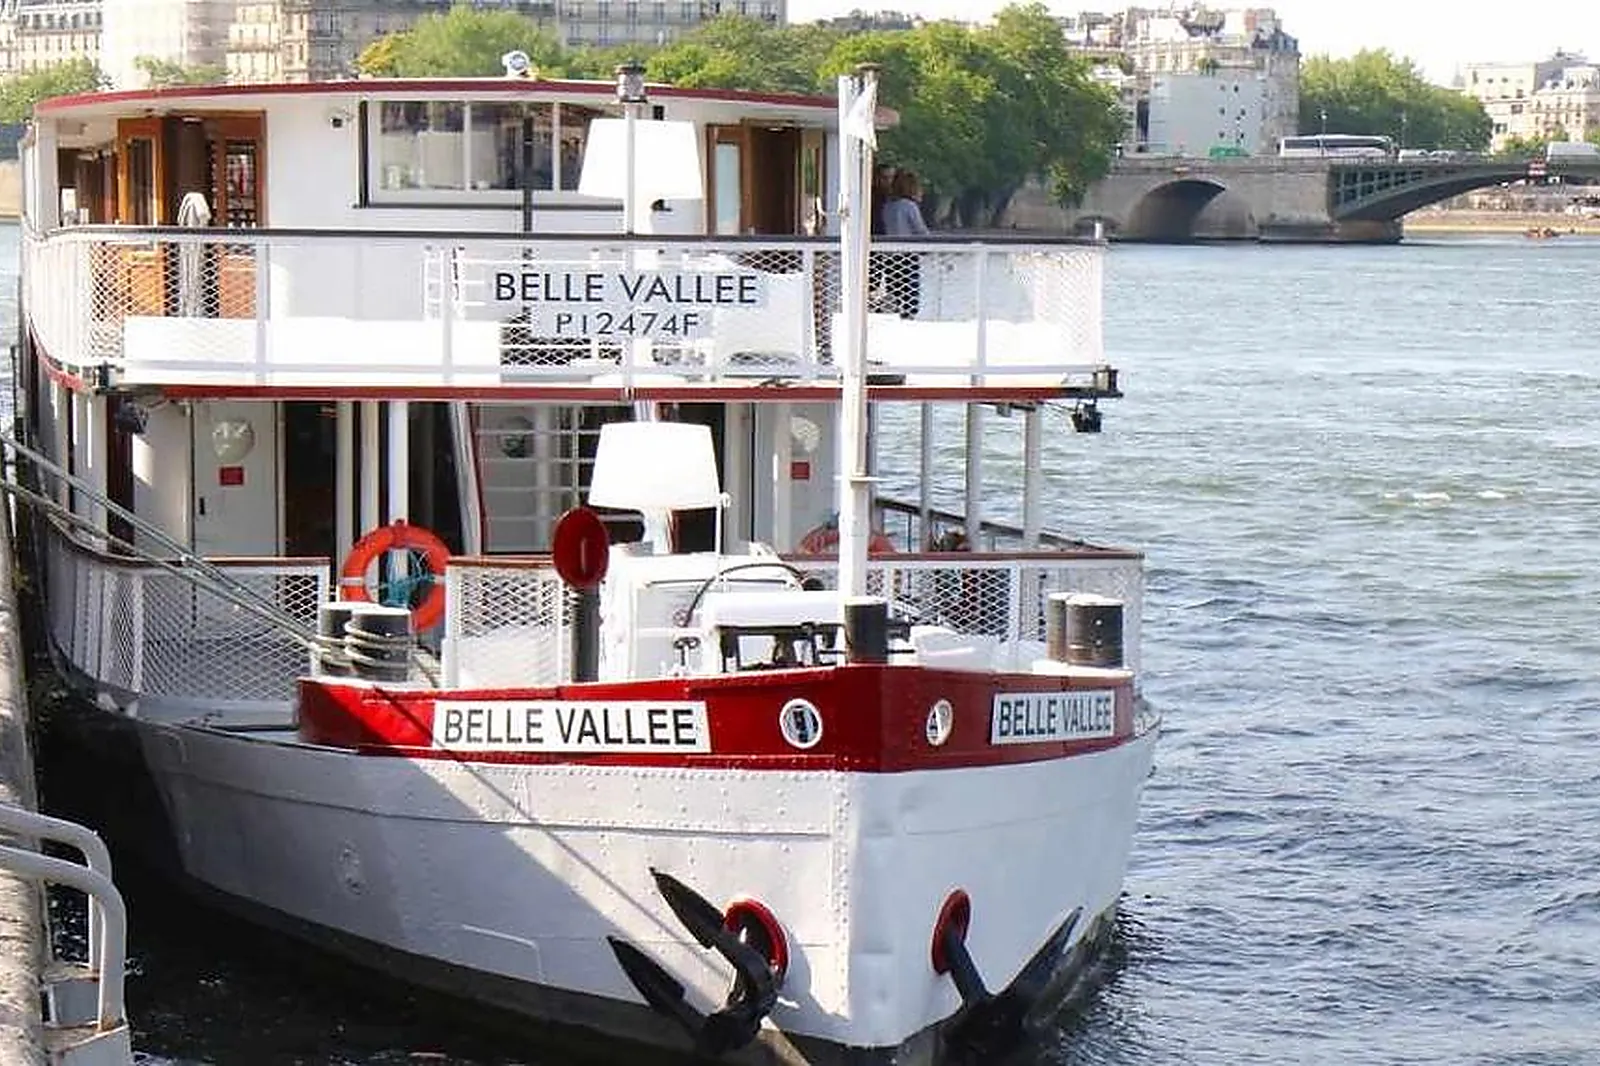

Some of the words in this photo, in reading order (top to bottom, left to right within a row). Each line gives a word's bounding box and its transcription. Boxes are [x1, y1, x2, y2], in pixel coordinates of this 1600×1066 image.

[495, 273, 604, 302] BELLE
[619, 274, 757, 303] VALLEE
[444, 708, 544, 744] BELLE
[556, 708, 697, 746] VALLEE
[999, 699, 1058, 736] BELLE
[1062, 697, 1111, 731] VALLEE
